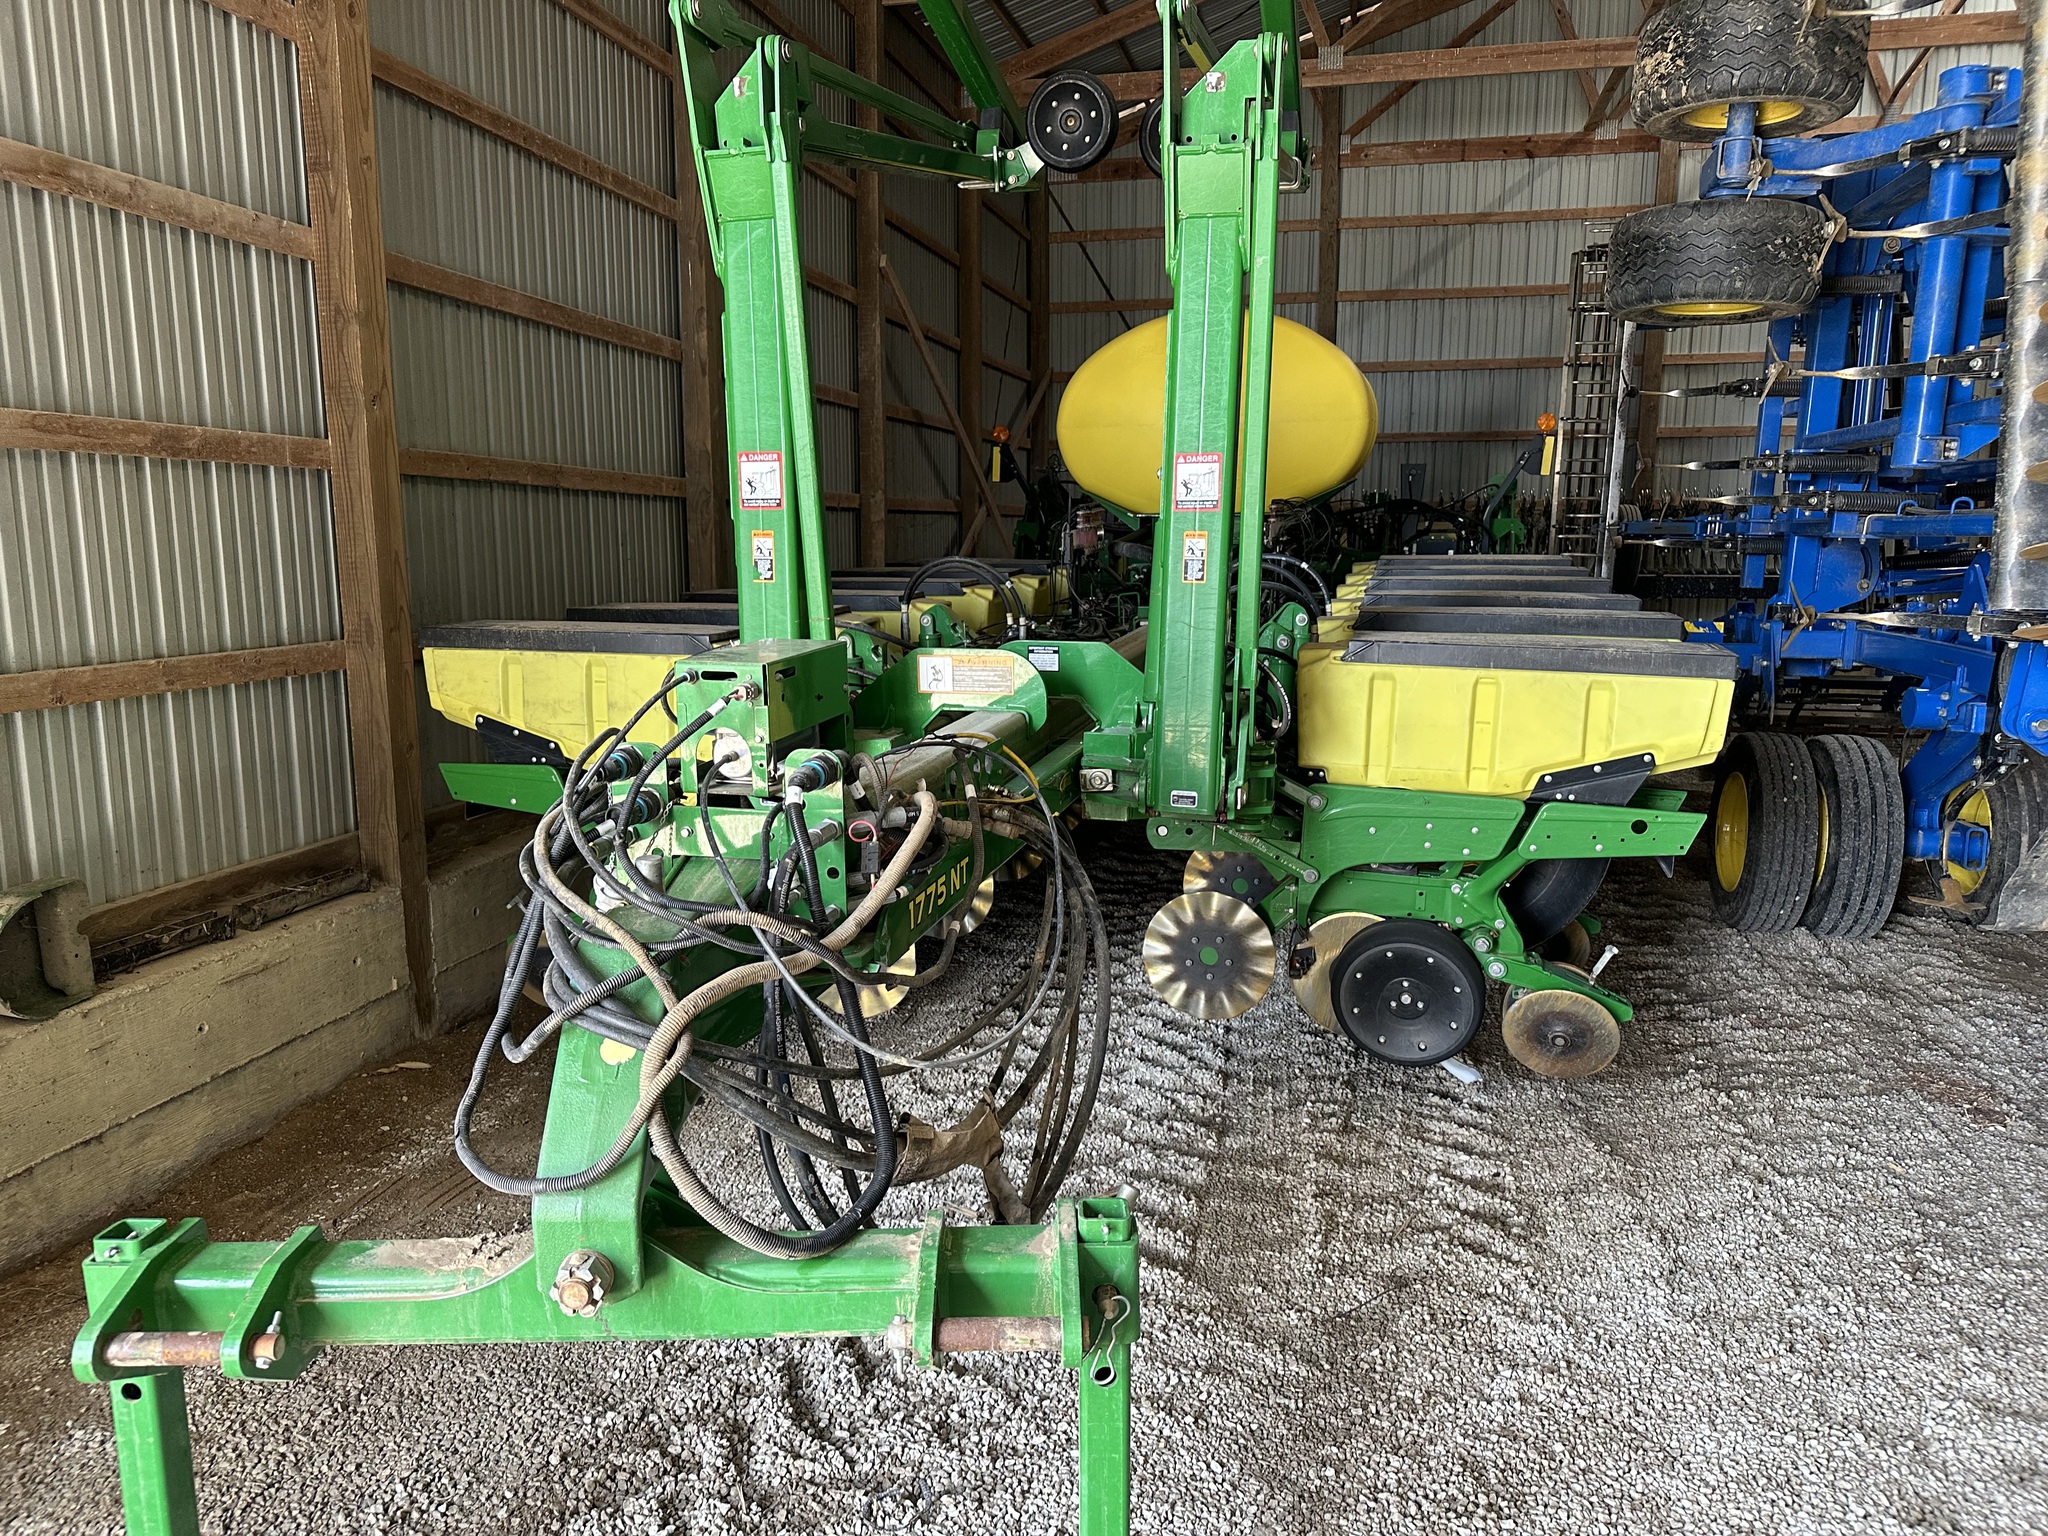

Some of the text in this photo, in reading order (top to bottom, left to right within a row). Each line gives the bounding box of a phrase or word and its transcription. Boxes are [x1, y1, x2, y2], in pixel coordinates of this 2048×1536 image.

[748, 453, 778, 461] DANGER
[1186, 455, 1219, 463] DANGER
[908, 856, 970, 930] 1775 NT
